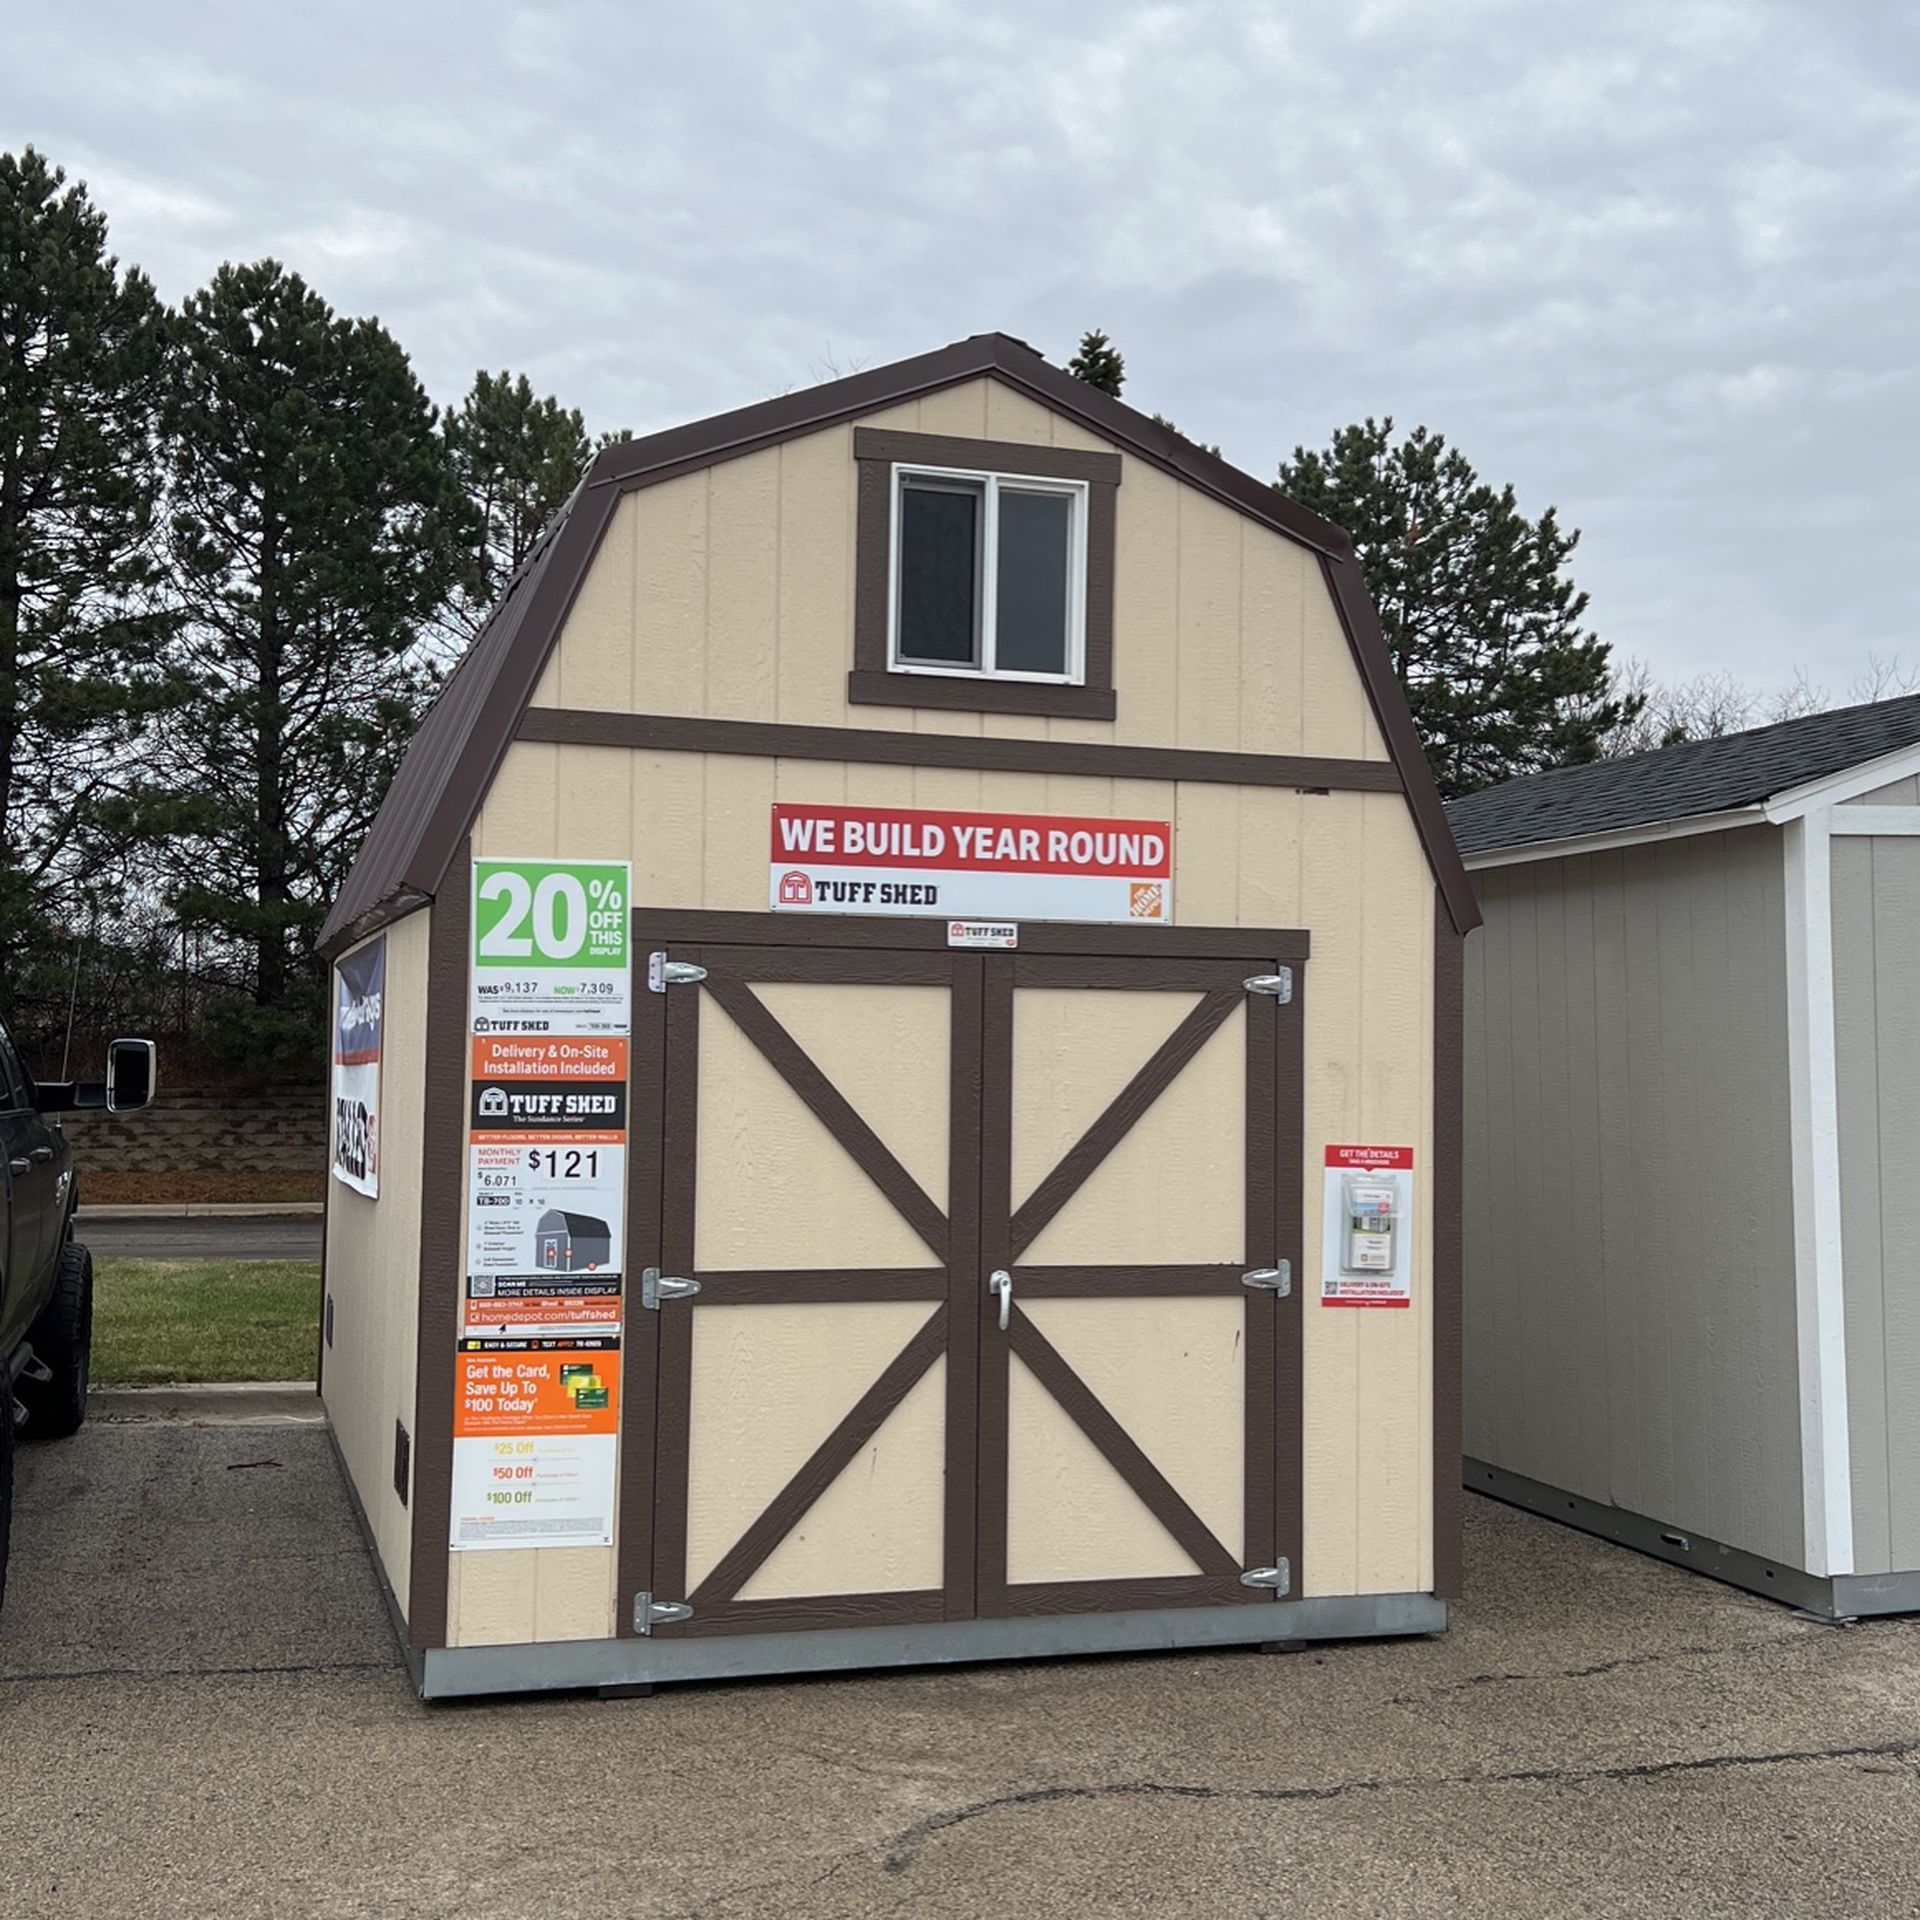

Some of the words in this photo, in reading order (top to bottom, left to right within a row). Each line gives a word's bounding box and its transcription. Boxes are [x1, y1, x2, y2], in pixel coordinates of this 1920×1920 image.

[779, 817, 835, 853] WE
[842, 820, 946, 858] BUILD
[952, 825, 1041, 862] YEAR
[1047, 829, 1165, 867] ROUND
[814, 880, 877, 904] TUFF
[880, 882, 938, 906] SHED
[589, 911, 623, 929] OFF
[589, 930, 623, 946] THIS
[965, 926, 990, 937] TUFF
[477, 984, 499, 994] WAS
[553, 986, 576, 995] NOW
[490, 1020, 521, 1031] TUFF
[521, 1020, 550, 1031] SHED
[491, 1044, 546, 1060] Delivery
[548, 1045, 558, 1058] &
[560, 1044, 609, 1058] On-Site
[484, 1061, 558, 1075] Installation
[560, 1061, 615, 1075] Included
[509, 1094, 564, 1114] TUFF
[565, 1095, 617, 1114] SHED
[1339, 1148, 1353, 1158] GET
[1369, 1150, 1400, 1159] DETAILS
[477, 1157, 521, 1166] PAYMENT
[477, 1148, 522, 1157] MONTHLY
[528, 1149, 598, 1179] $121
[497, 1288, 521, 1296] MORE
[522, 1288, 556, 1296] DETAILS
[557, 1287, 583, 1296] INSIDE
[584, 1286, 617, 1295] DISPLAY
[482, 1310, 616, 1322] homedepot.com/tuffshed
[466, 1365, 489, 1379] Get
[492, 1364, 513, 1378] the
[516, 1364, 551, 1380] Card,
[465, 1381, 496, 1395] Save
[500, 1381, 519, 1397] Up
[523, 1380, 537, 1394] To
[464, 1398, 493, 1412] $100
[516, 1441, 534, 1455] Off
[493, 1467, 513, 1480] $50
[515, 1466, 533, 1479] Off
[486, 1491, 511, 1504] $100
[514, 1490, 532, 1504] Off
